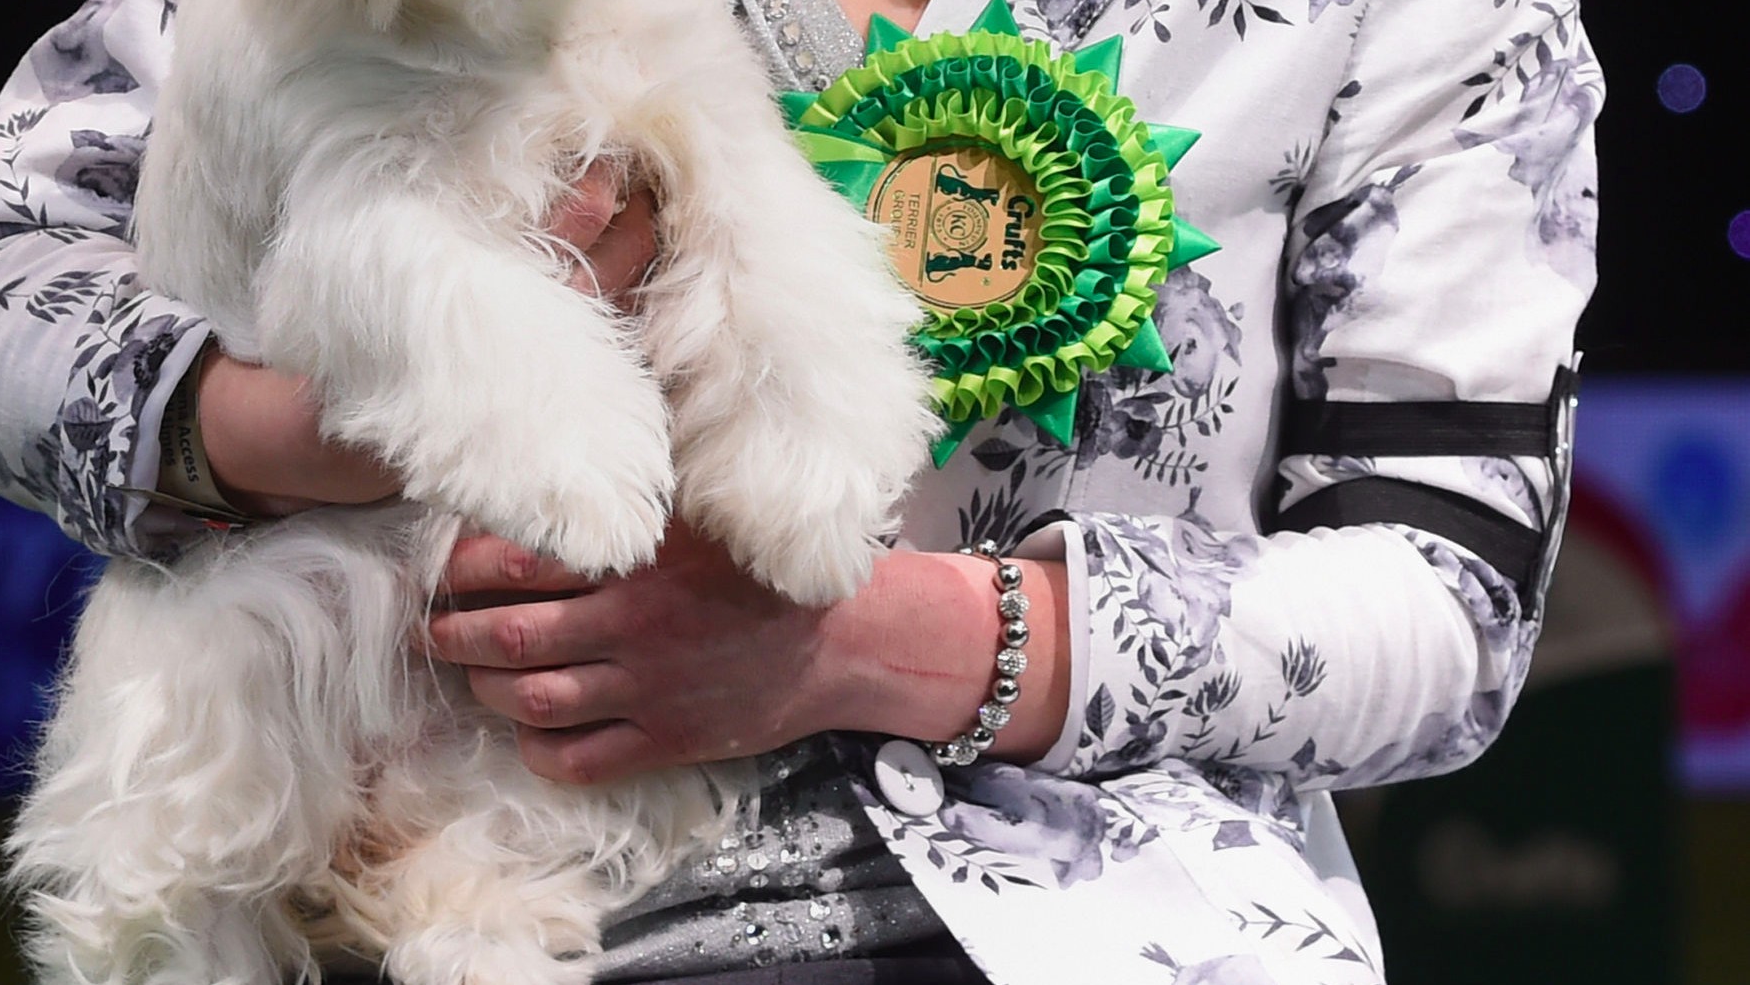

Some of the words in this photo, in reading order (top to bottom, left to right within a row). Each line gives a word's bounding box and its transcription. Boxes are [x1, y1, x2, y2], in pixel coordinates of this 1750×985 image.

[904, 193, 922, 249] TERRIER
[949, 214, 968, 237] KC
[1000, 195, 1035, 271] Crufts
[178, 426, 199, 483] Access
